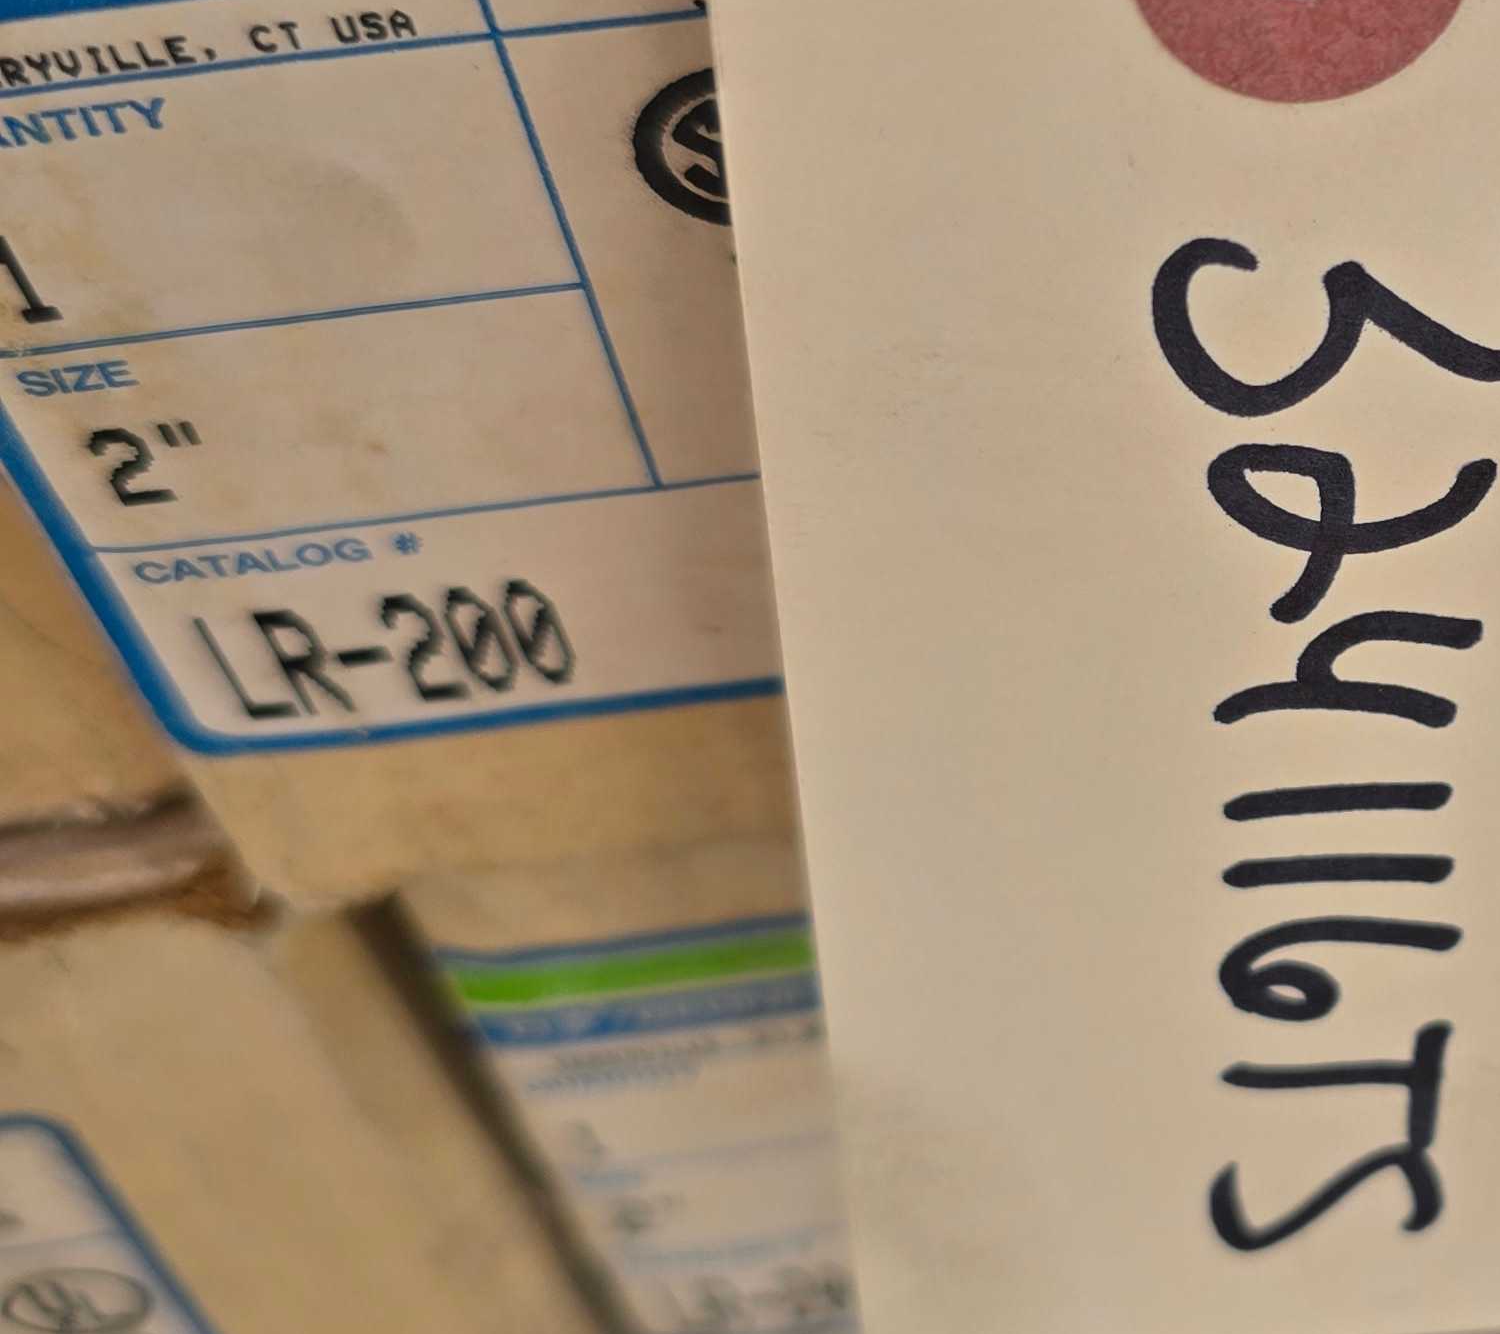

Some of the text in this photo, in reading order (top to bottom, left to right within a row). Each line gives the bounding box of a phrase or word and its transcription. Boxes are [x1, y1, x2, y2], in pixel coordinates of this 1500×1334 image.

[248, 21, 304, 54] CT
[330, 9, 418, 45] USA
[16, 359, 140, 398] SIZE
[84, 420, 203, 507] 2"
[134, 531, 425, 585] CATALOG #
[192, 578, 578, 720] LR-200
